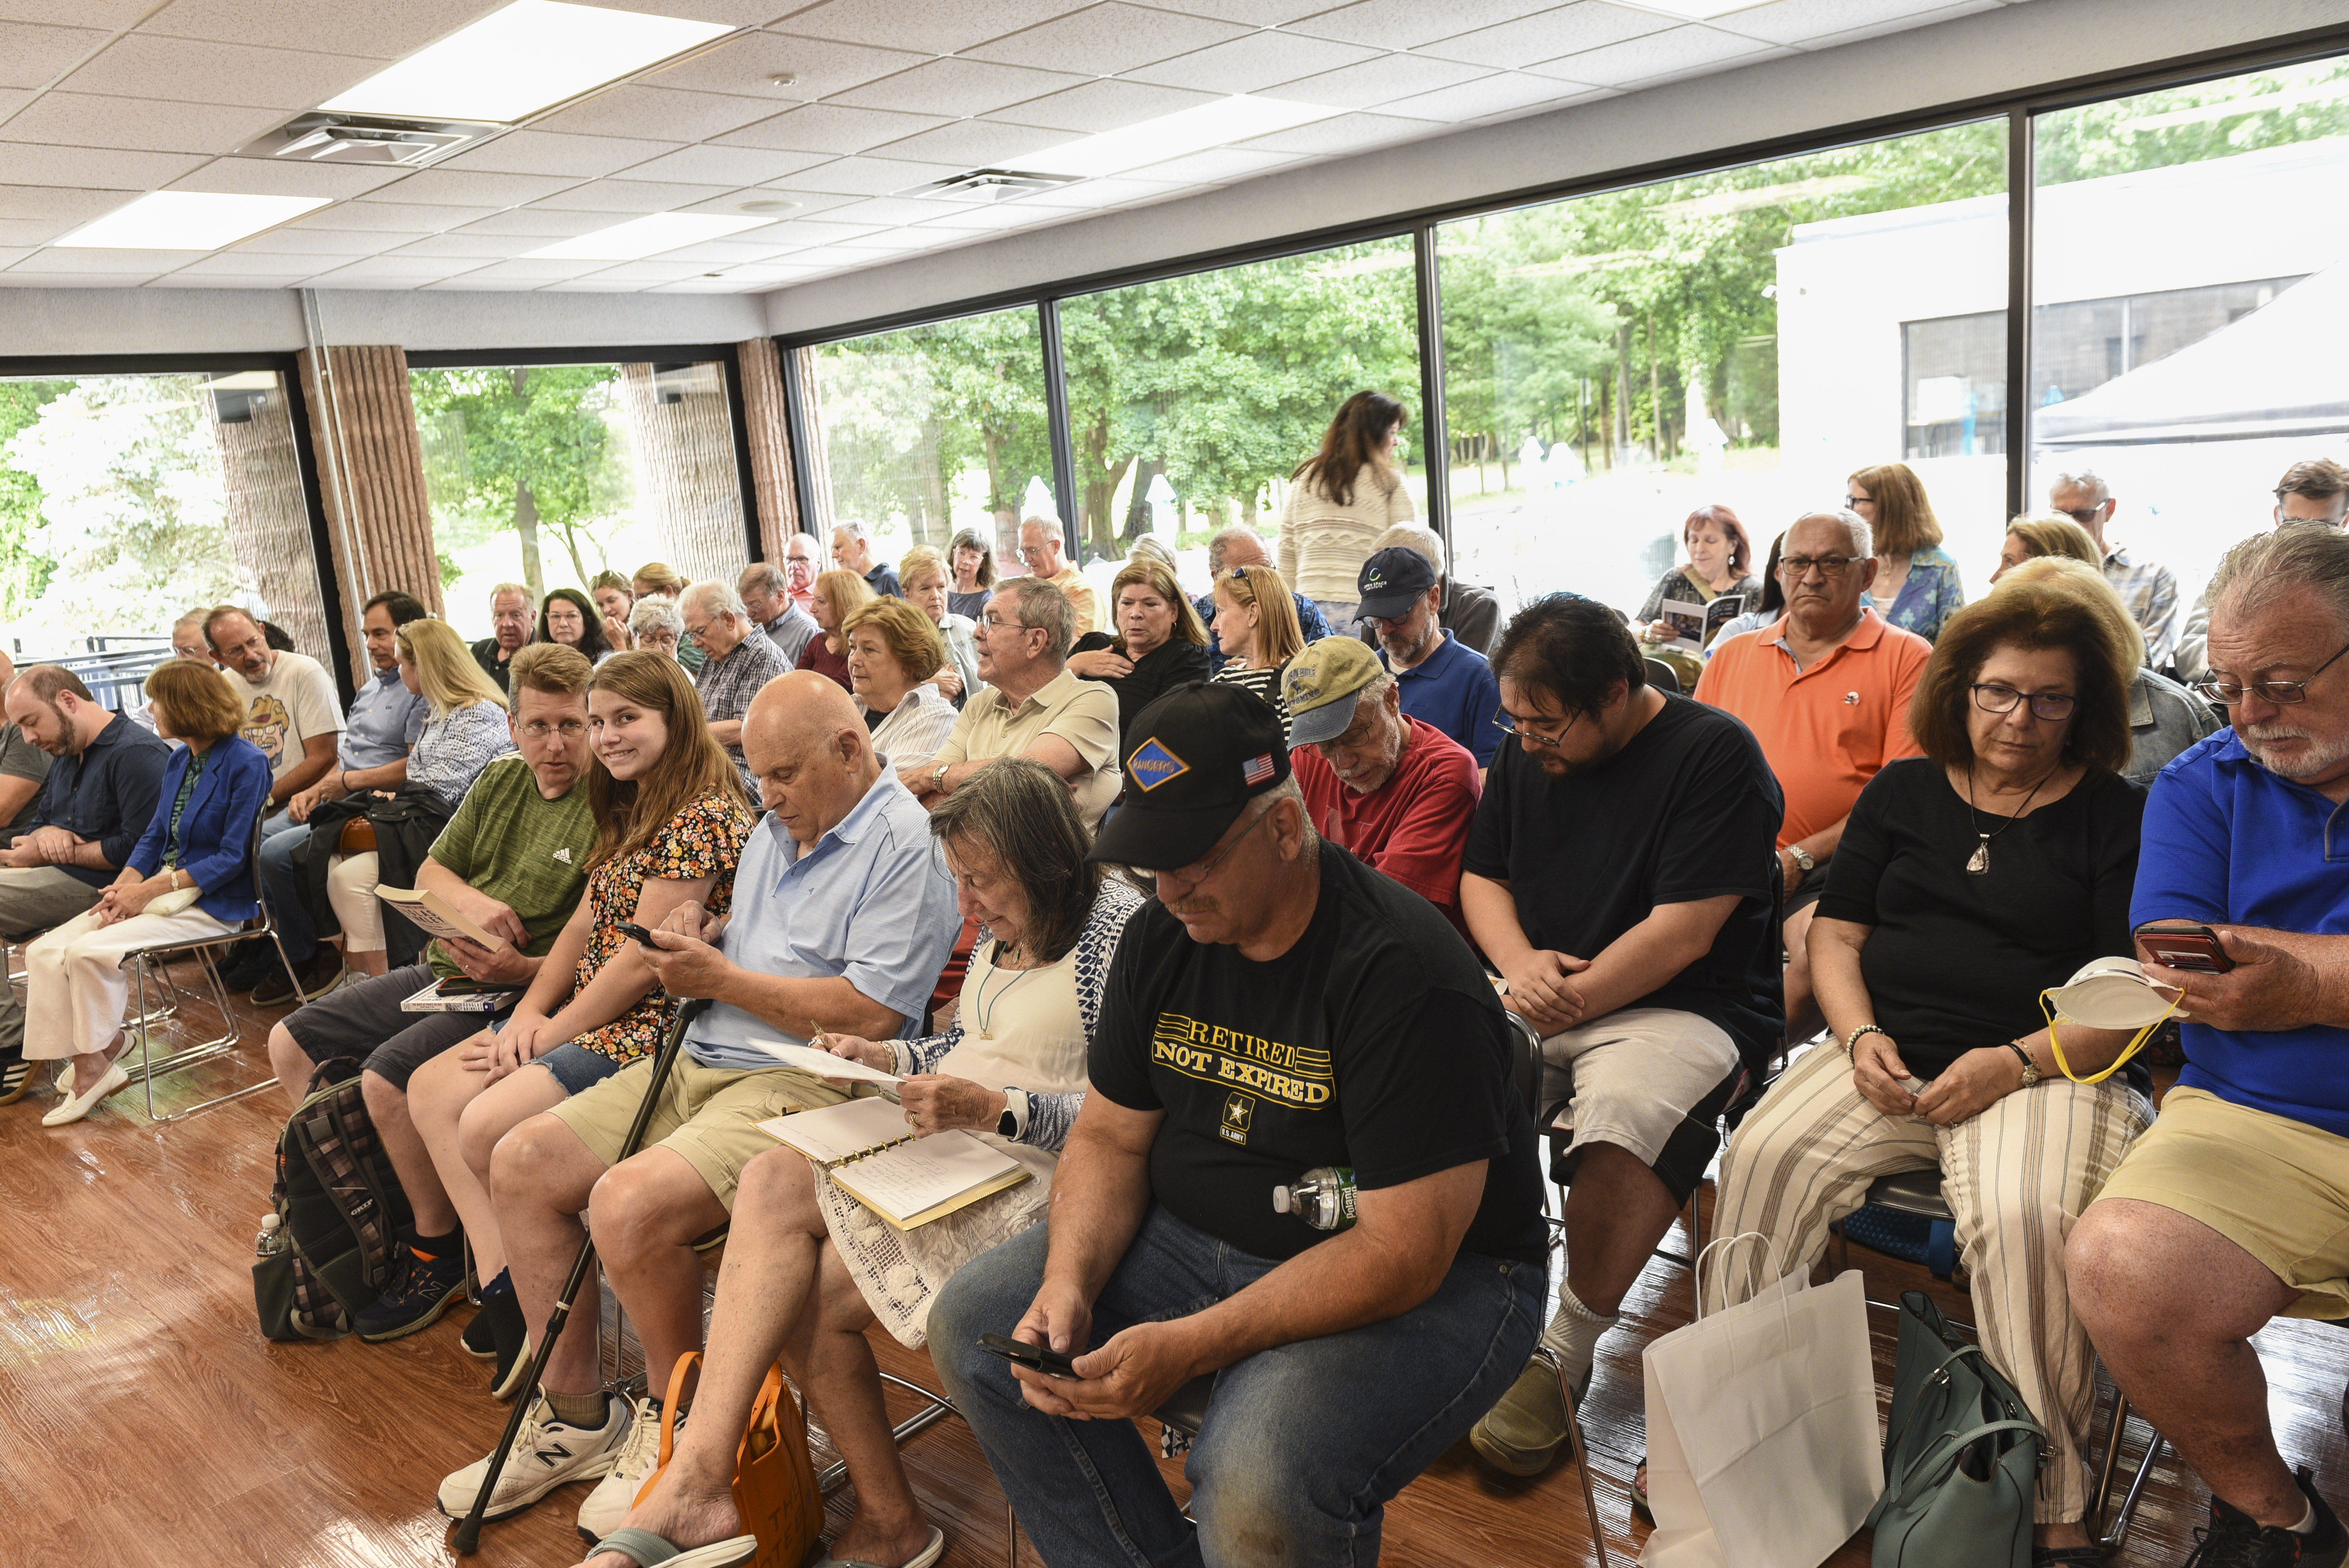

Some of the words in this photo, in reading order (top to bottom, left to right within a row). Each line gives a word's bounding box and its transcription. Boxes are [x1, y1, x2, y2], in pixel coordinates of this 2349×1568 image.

[1133, 758, 1175, 774] RANGERS
[553, 852, 572, 865] adidas
[1188, 1020, 1295, 1068] RETIRED
[1154, 1040, 1213, 1072] NOT
[1218, 1057, 1331, 1103] EXPIRED
[1341, 1187, 1357, 1219] Poland
[534, 1441, 574, 1469] N
[768, 1476, 799, 1532] THE
